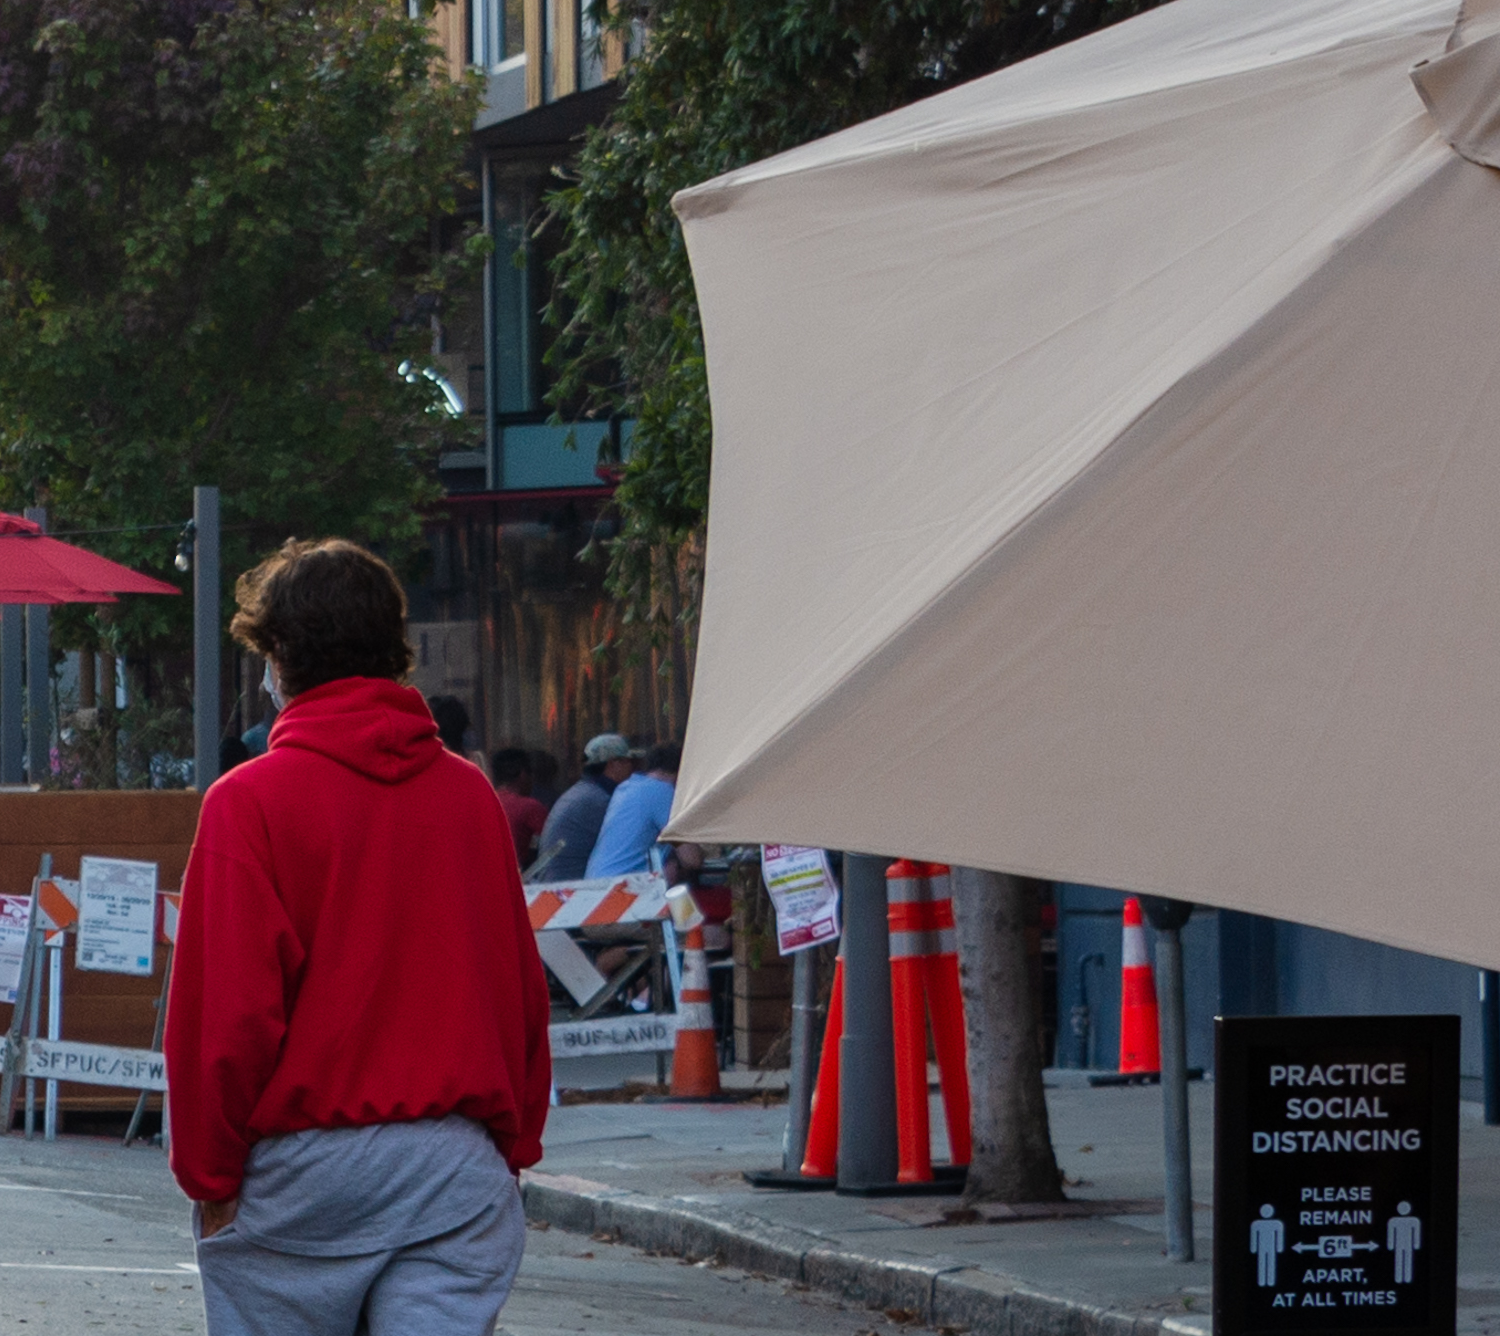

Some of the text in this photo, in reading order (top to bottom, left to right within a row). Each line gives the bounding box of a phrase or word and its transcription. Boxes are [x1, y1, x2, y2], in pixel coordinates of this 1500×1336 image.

[1269, 1063, 1406, 1087] PRACTICE
[1285, 1096, 1389, 1120] SOCIAL
[1252, 1128, 1422, 1154] DISTANCING
[1301, 1186, 1372, 1202] PLEASE
[1299, 1210, 1373, 1226] REMAIN
[1323, 1238, 1348, 1256] 6ft
[1302, 1268, 1368, 1285] APART,
[1272, 1290, 1398, 1308] AT ALL TIMES
